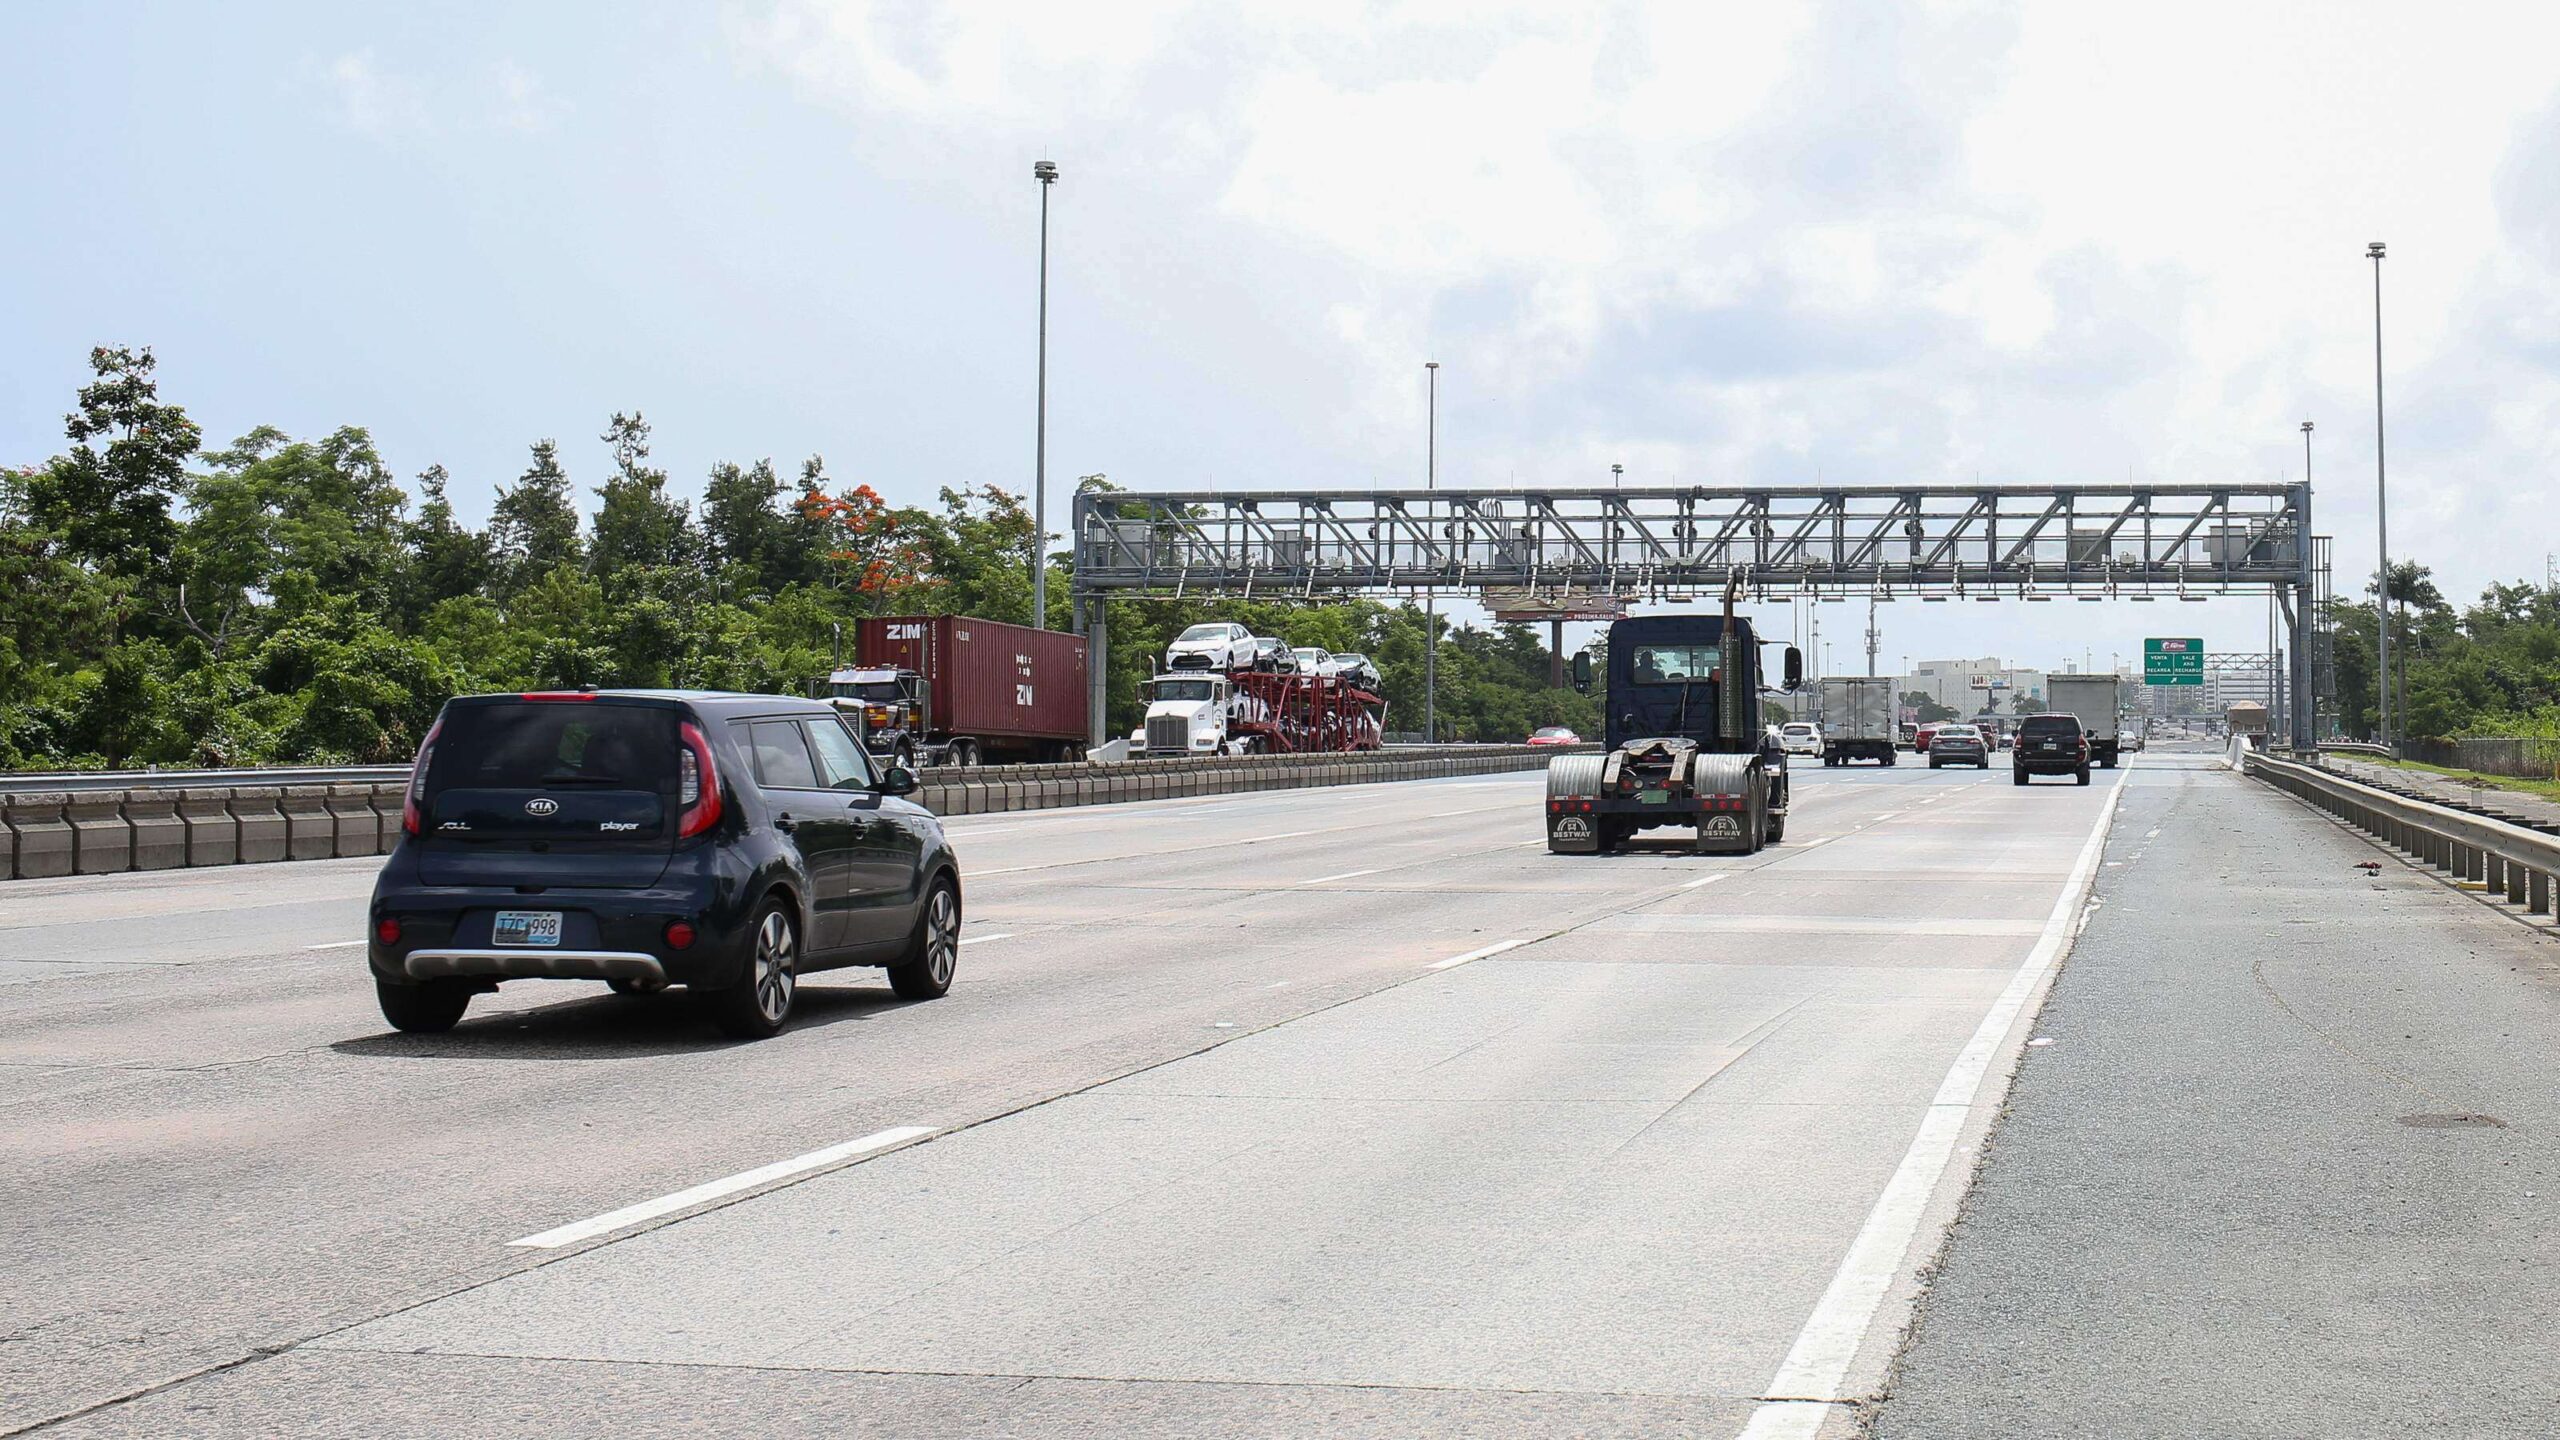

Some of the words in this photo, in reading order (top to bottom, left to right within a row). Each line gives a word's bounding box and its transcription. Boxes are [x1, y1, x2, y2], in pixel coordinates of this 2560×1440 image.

[887, 624, 921, 640] ZIM
[530, 802, 553, 812] KIA
[600, 821, 639, 831] player
[531, 918, 557, 935] 998
